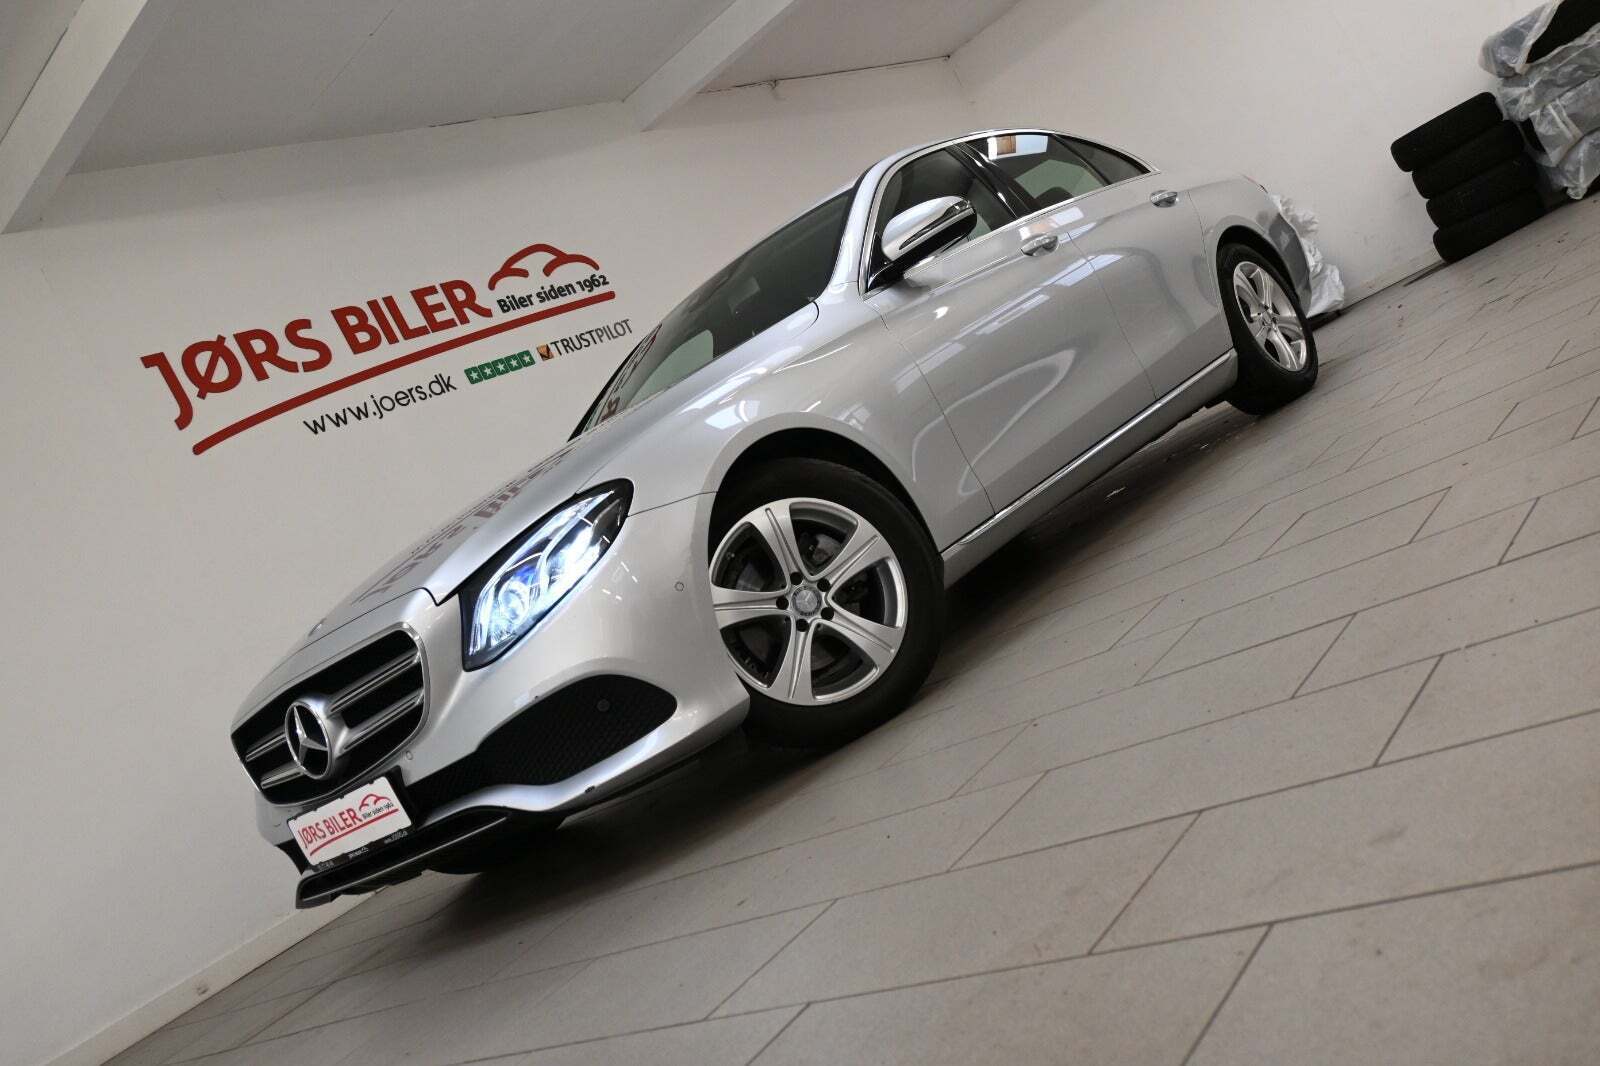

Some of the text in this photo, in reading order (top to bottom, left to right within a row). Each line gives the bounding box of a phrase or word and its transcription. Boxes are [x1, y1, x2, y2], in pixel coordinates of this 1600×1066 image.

[496, 273, 610, 314] Biler siden 1962
[139, 279, 494, 431] JØRS BILER
[550, 319, 633, 356] TRUSTPILOT
[303, 374, 457, 434] www.joers.dk
[298, 822, 327, 849] JØRS
[323, 807, 363, 836] BILER
